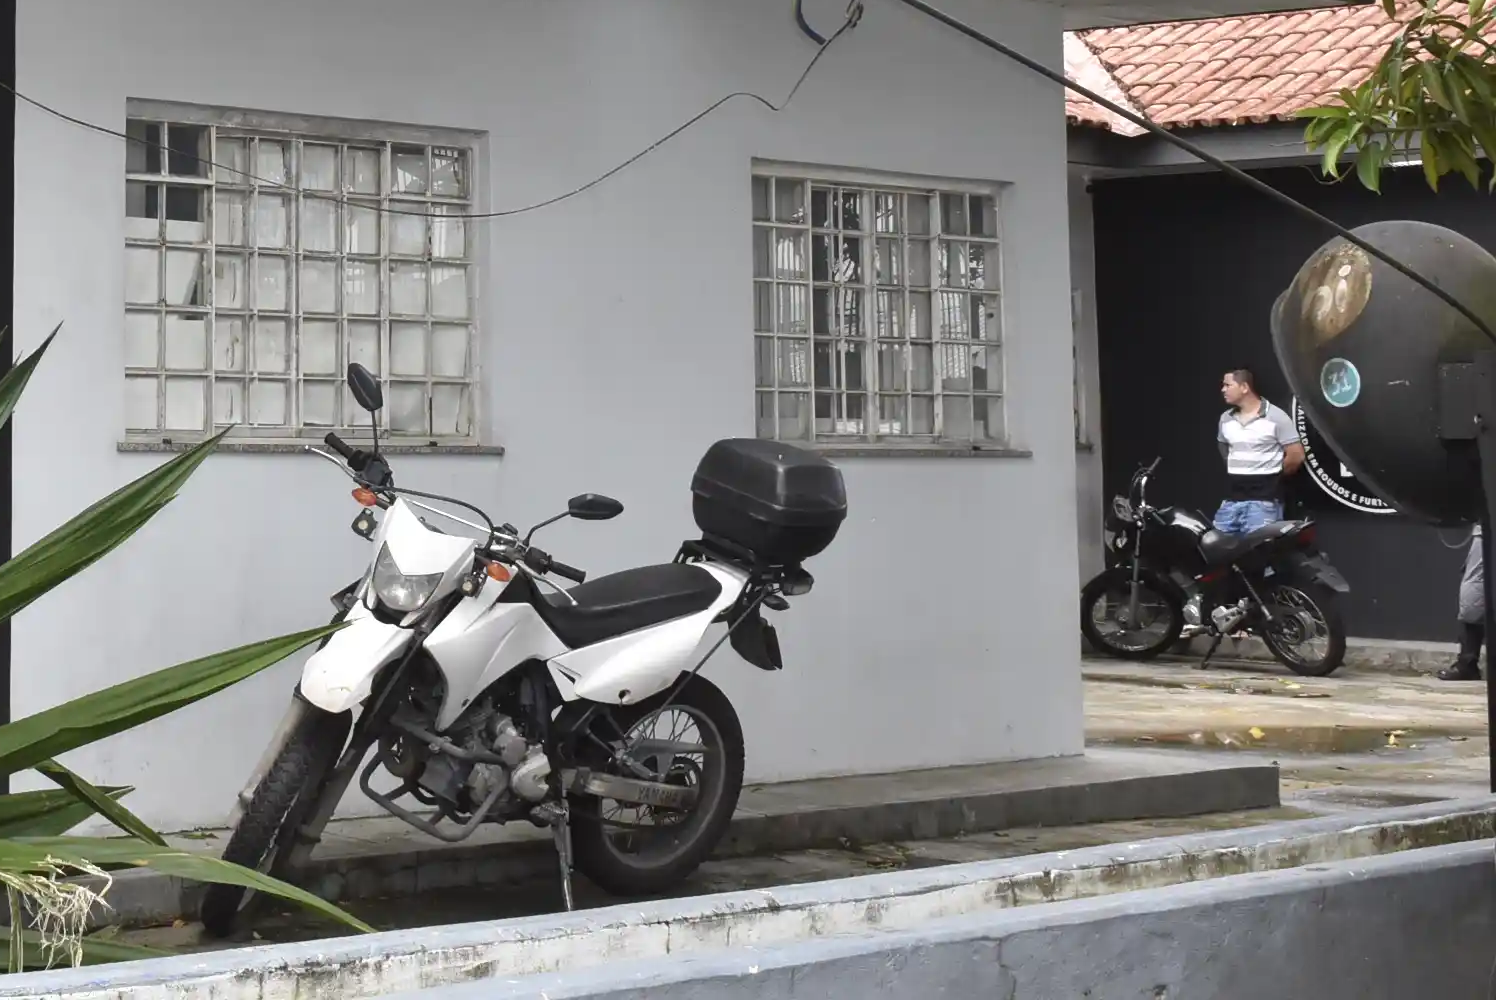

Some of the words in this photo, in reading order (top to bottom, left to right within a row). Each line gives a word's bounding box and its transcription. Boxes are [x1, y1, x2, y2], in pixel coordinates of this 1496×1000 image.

[1297, 405, 1312, 453] ALIZADA
[1307, 453, 1319, 469] EM
[1316, 467, 1351, 498] ROUBOS
[1351, 494, 1358, 502] E
